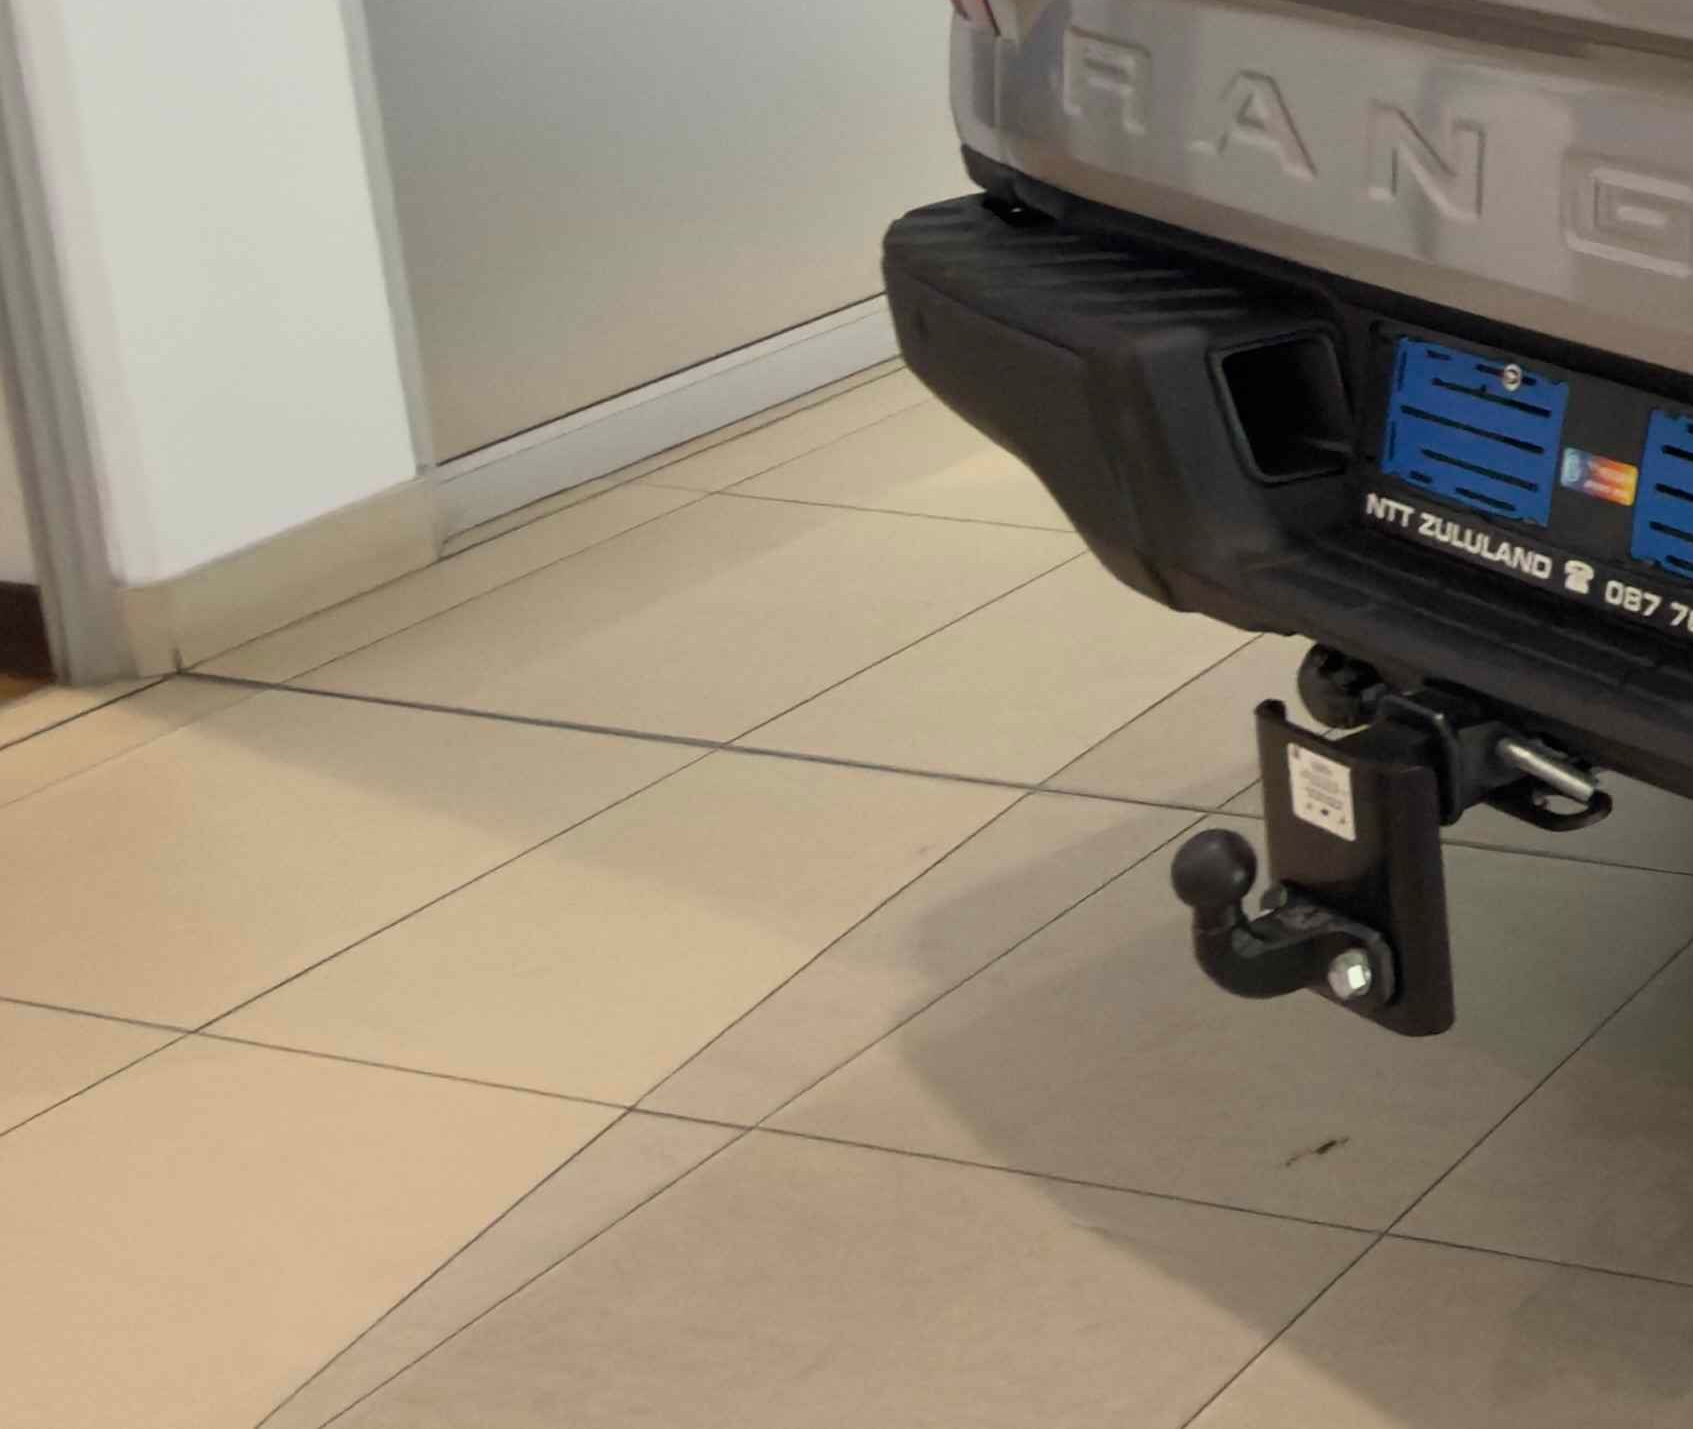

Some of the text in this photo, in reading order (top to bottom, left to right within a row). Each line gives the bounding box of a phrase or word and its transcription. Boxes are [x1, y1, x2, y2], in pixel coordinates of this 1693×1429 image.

[1365, 493, 1414, 528] NTT
[1419, 512, 1553, 580] ZULULAND
[1605, 579, 1662, 616] 087
